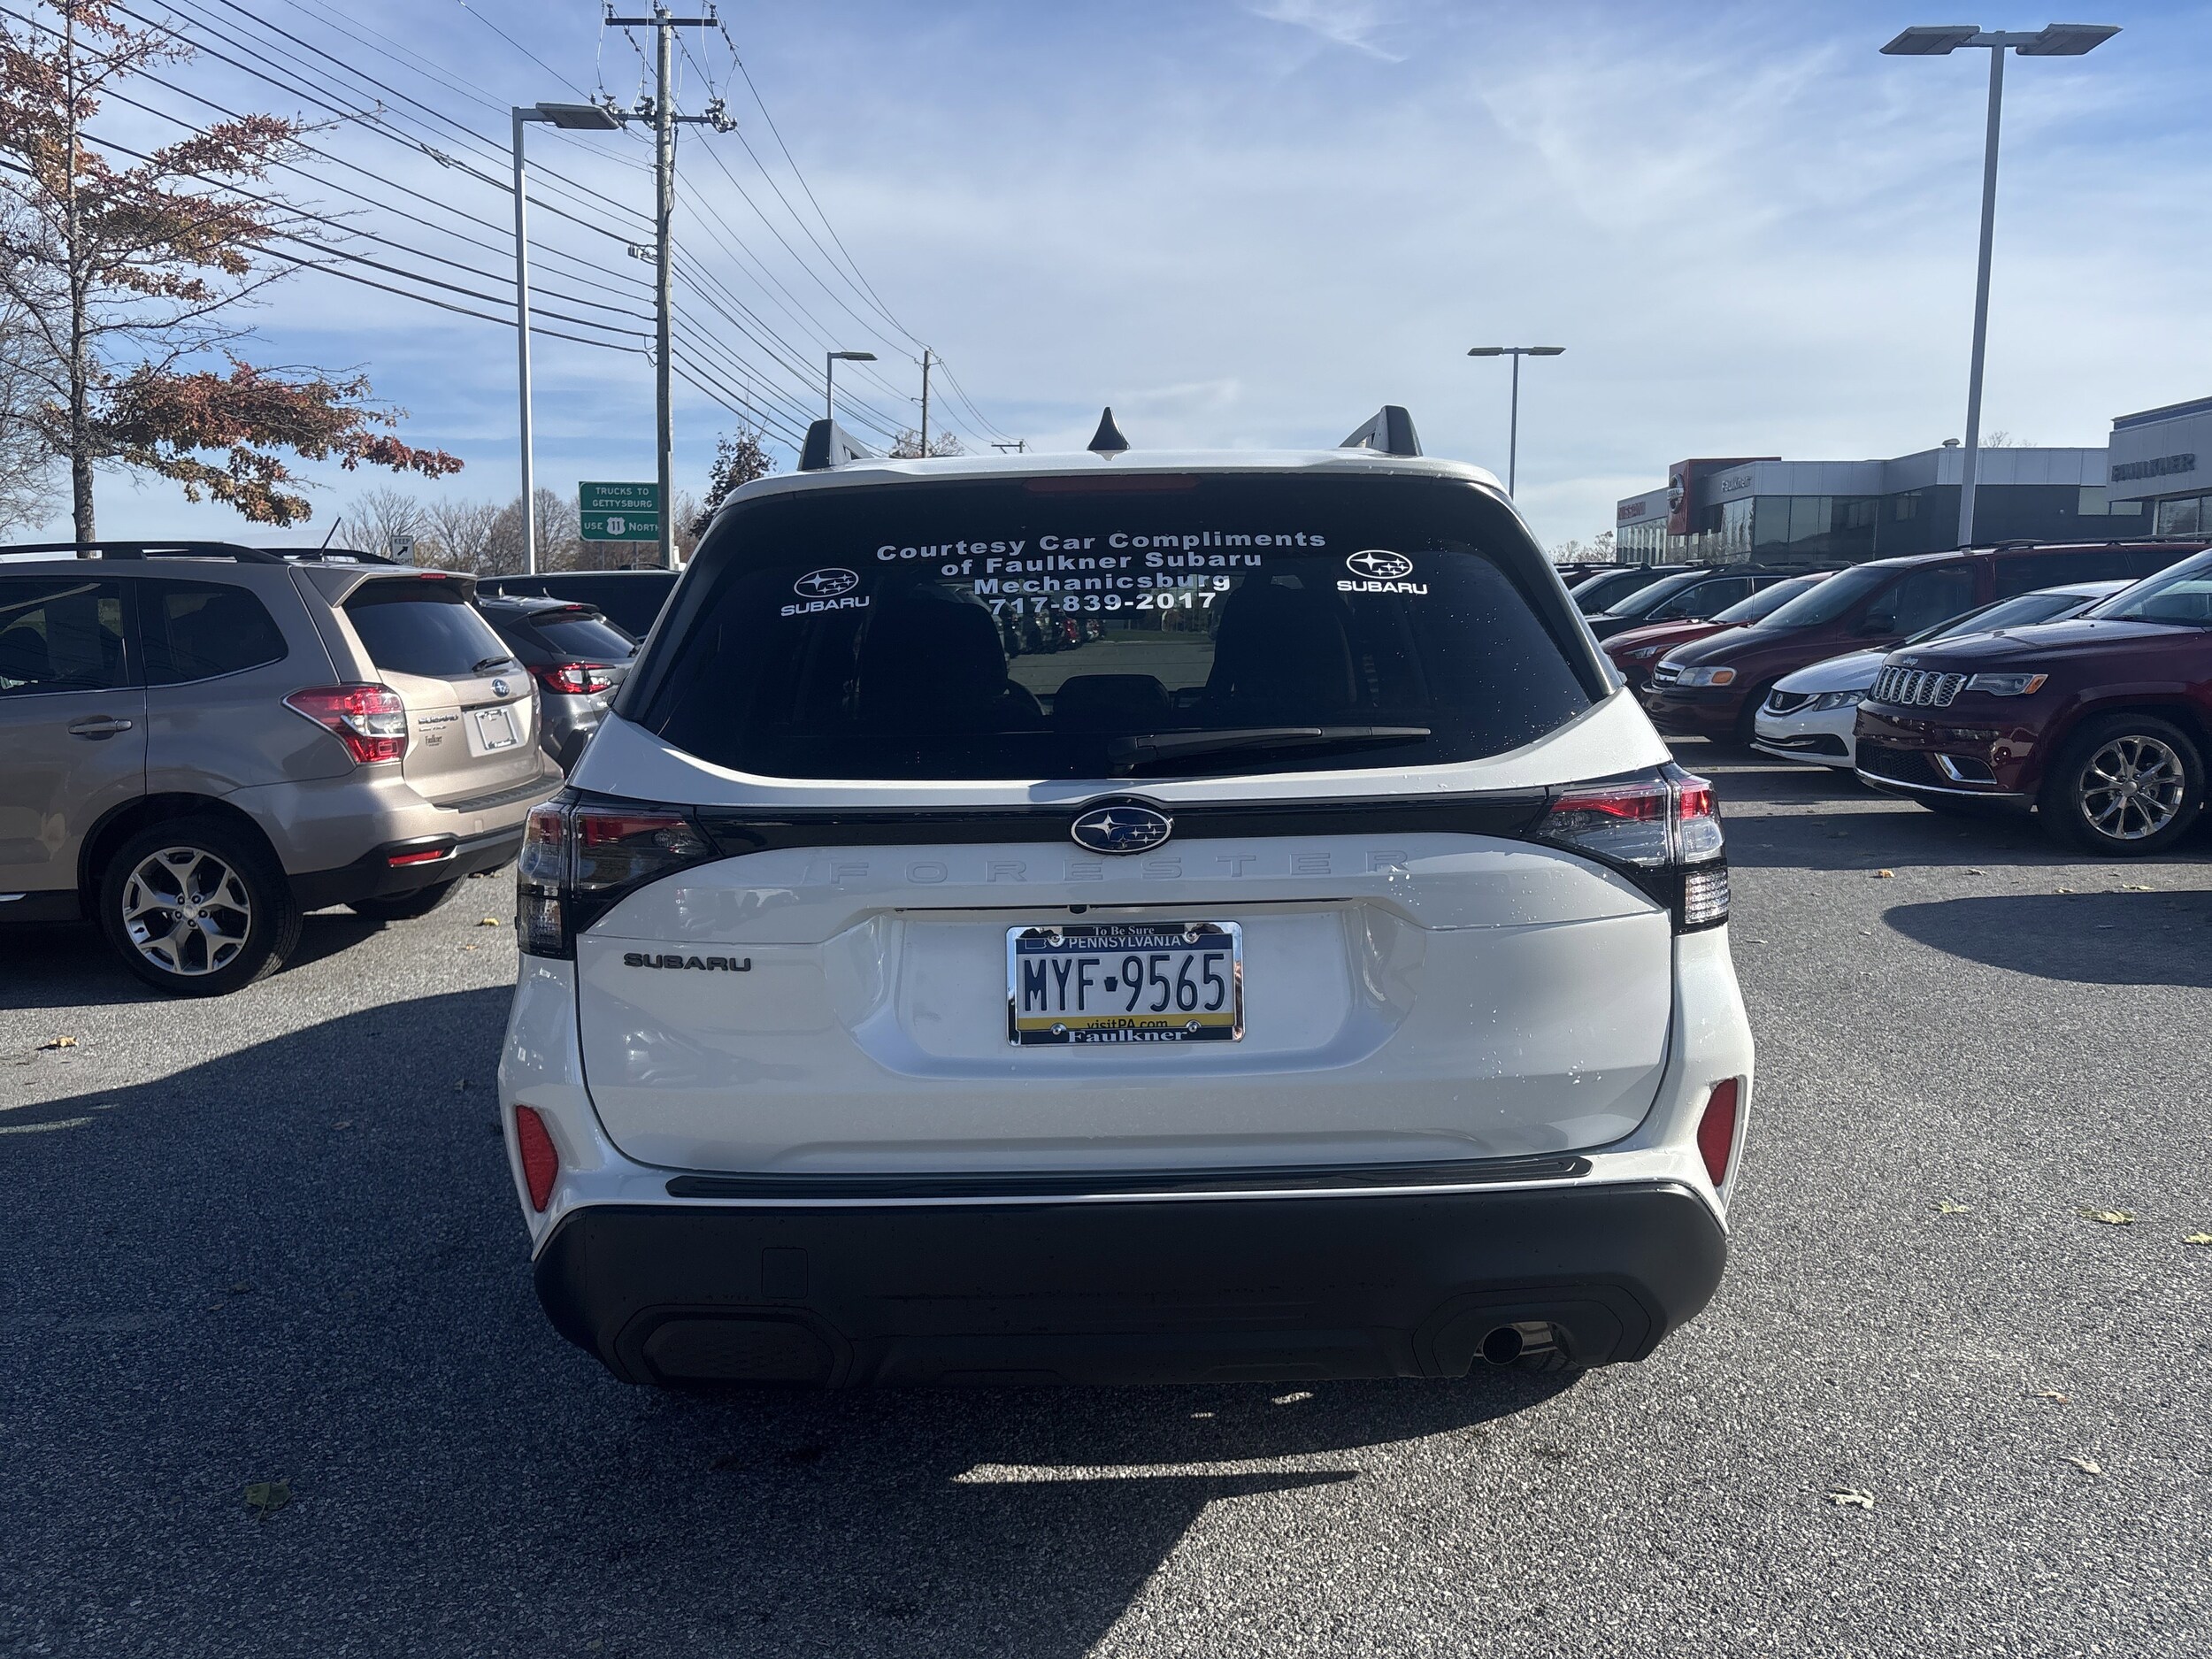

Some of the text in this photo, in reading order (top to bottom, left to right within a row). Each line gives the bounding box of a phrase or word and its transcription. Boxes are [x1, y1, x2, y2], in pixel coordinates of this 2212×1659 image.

[595, 487, 632, 495] TRUCKS
[592, 499, 653, 508] GETTYSBURG
[611, 520, 620, 531] 11
[876, 531, 1326, 561] Courtesy Car Compliments
[941, 551, 1262, 576] of Faulkner Subaru
[974, 572, 1231, 595] Mechanicsburg
[1336, 580, 1428, 595] SUBARU
[780, 595, 870, 617] SUBARU
[988, 592, 1217, 616] 717-839-2017
[828, 849, 1409, 886] FORESTER
[1093, 926, 1155, 936] To Be Sure
[1069, 935, 1181, 949] PENNSYLVANIA
[624, 953, 751, 972] SUBARU
[1087, 1018, 1168, 1029] visitPA.com
[1067, 1029, 1188, 1043] Faulkner
